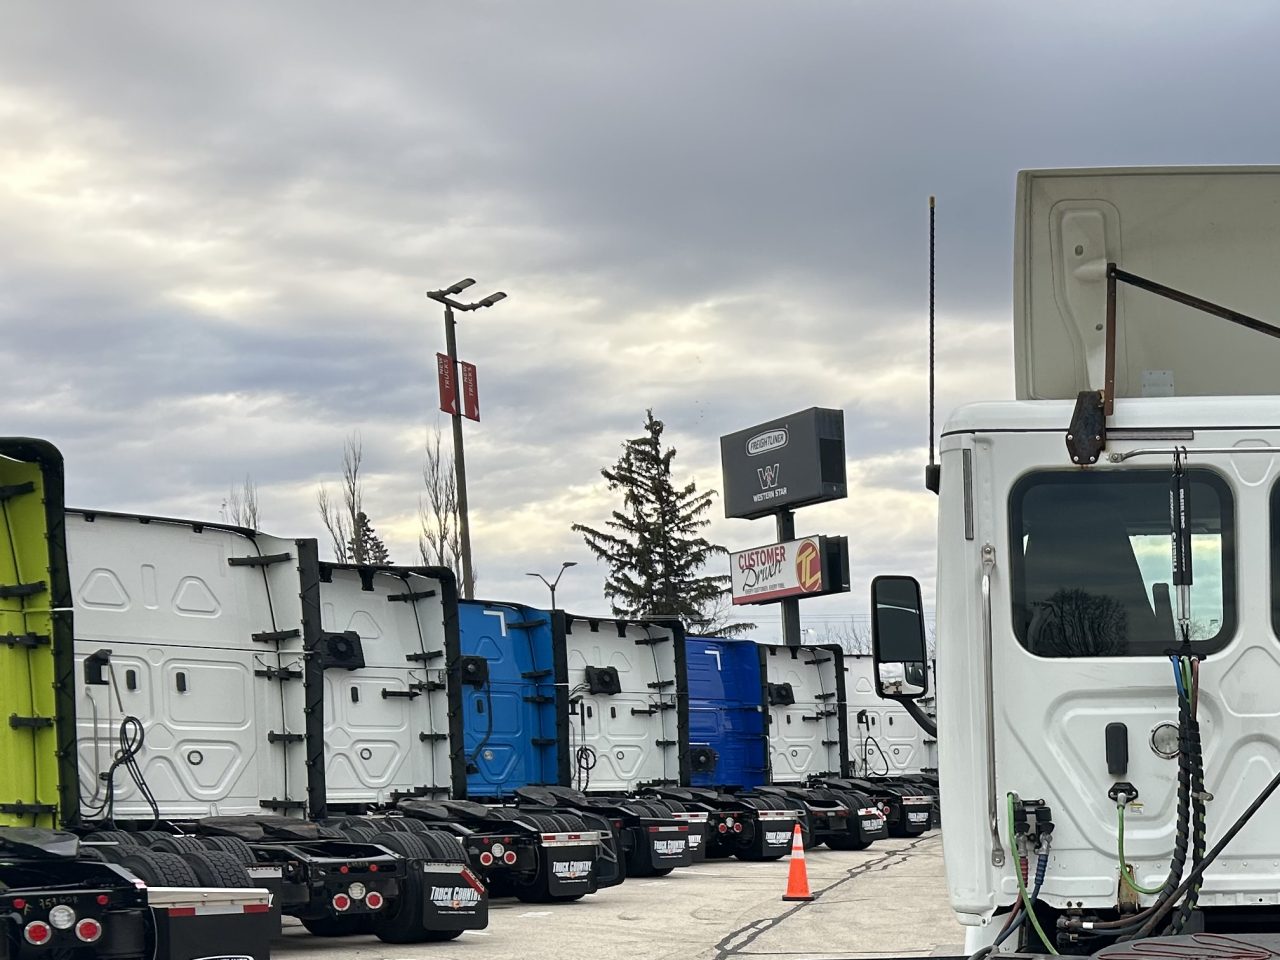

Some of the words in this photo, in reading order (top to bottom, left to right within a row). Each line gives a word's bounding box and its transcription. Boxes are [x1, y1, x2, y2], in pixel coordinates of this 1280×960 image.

[750, 433, 785, 451] FREIGHTLINER
[753, 491, 775, 502] WESTERN
[775, 487, 787, 496] STAR
[738, 546, 786, 570] CUSTOMER
[553, 861, 570, 873] TRUCK
[570, 861, 592, 872] COUNTRY
[430, 886, 453, 901] TRUCK
